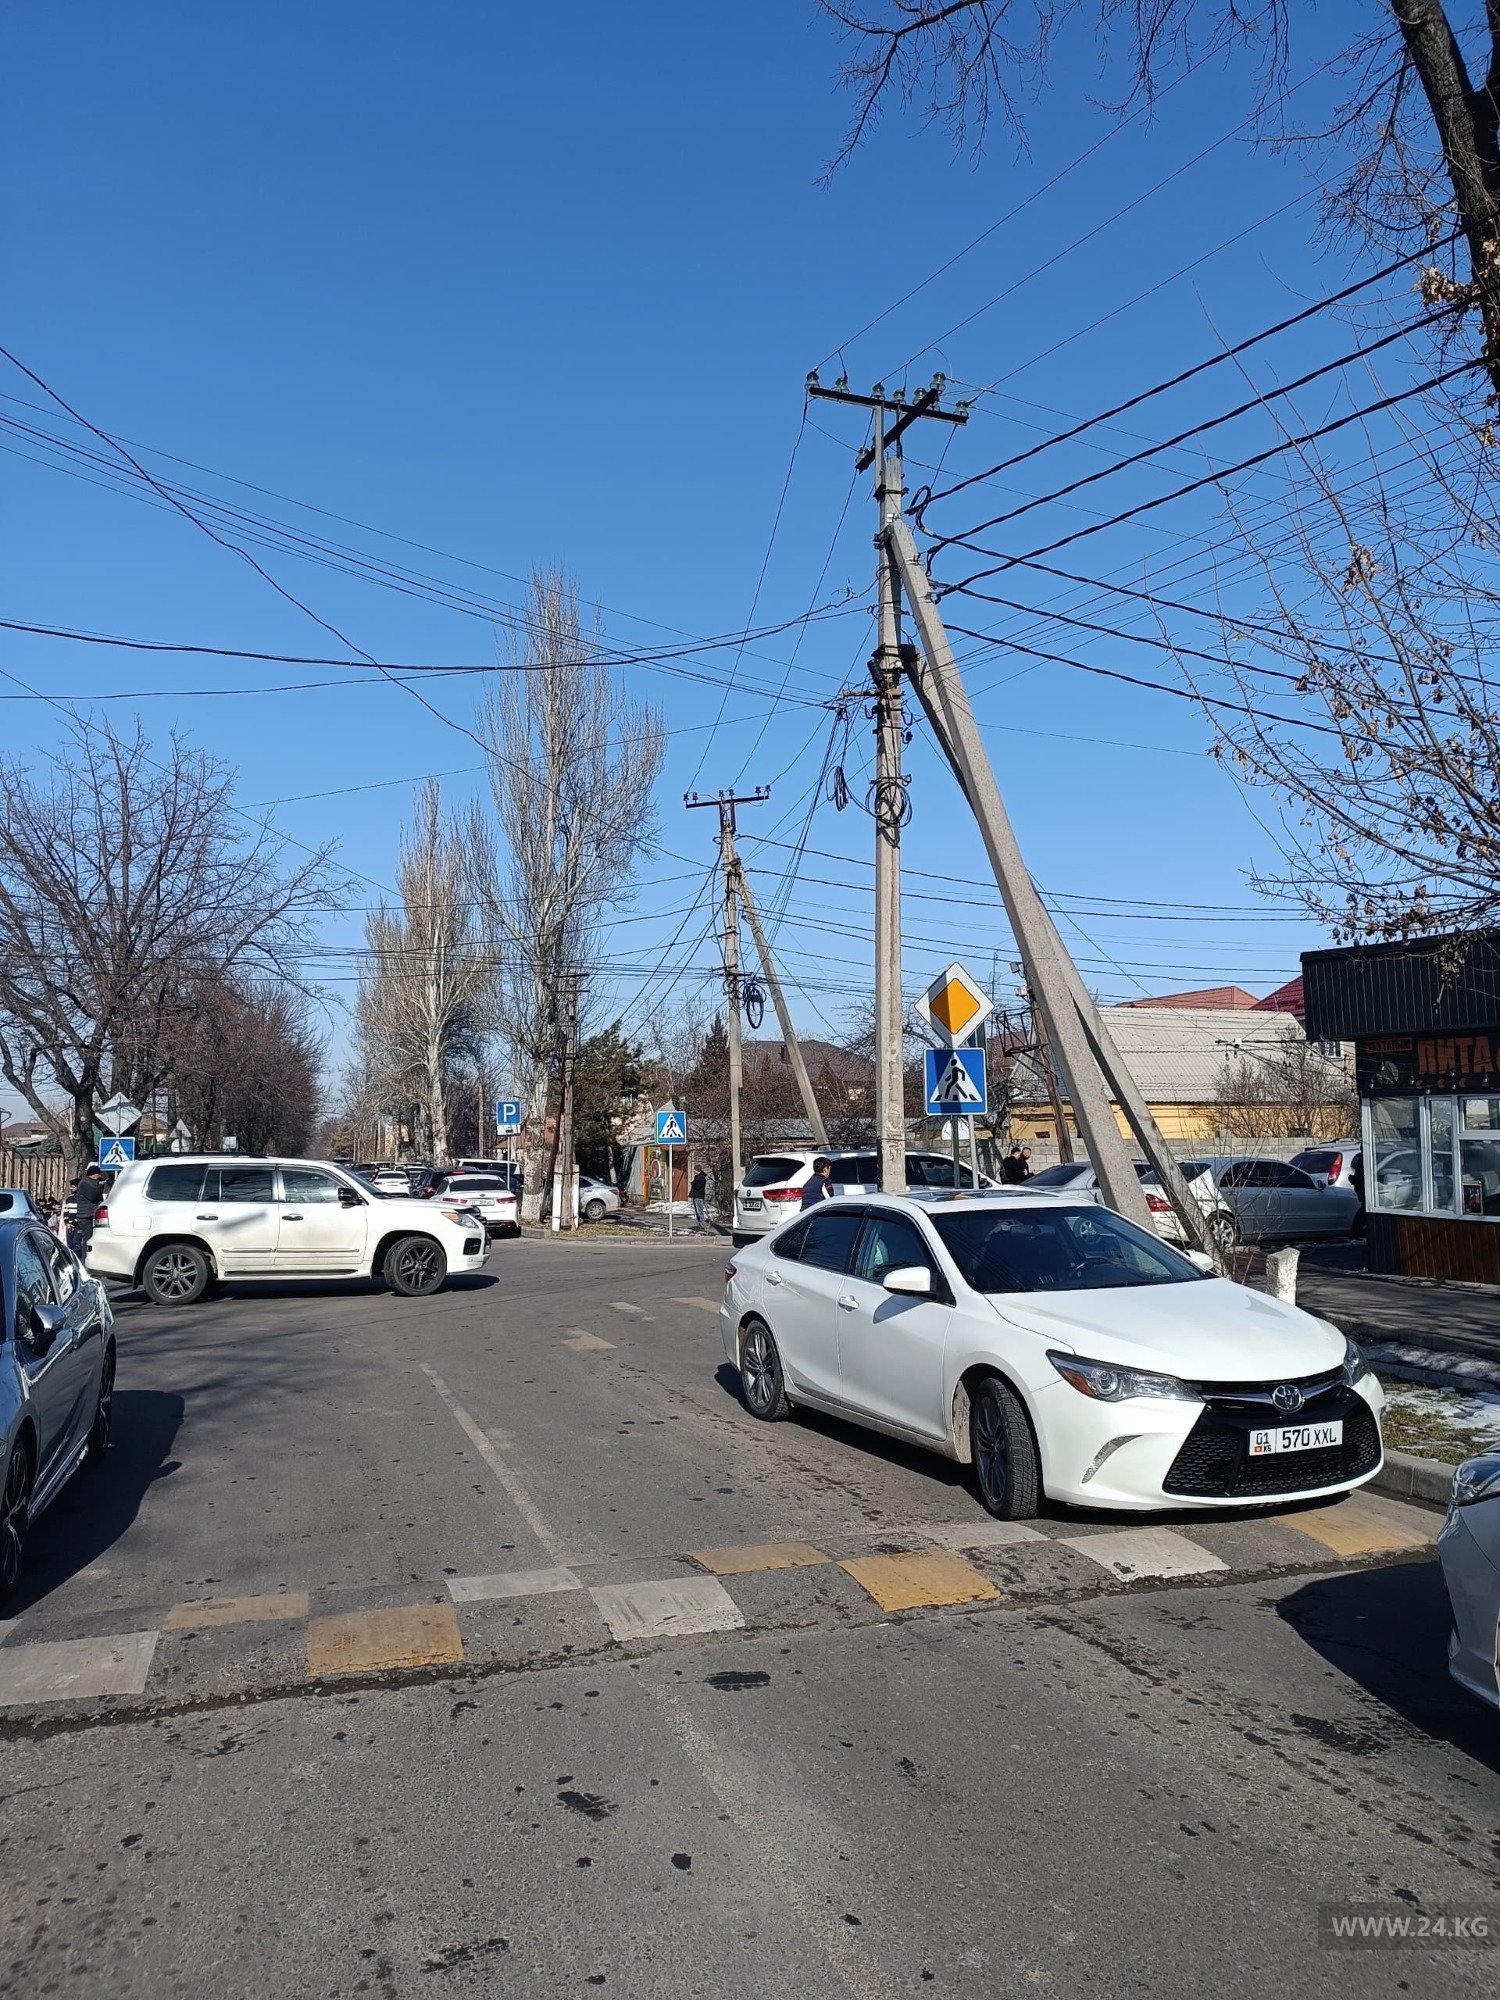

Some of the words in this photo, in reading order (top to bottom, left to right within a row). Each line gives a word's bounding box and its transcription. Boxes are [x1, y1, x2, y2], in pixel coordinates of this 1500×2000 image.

[503, 1103, 516, 1122] P
[1256, 1432, 1270, 1445] 01
[1282, 1428, 1310, 1449] 570
[1313, 1427, 1337, 1446] XXL
[1263, 1444, 1272, 1453] KG
